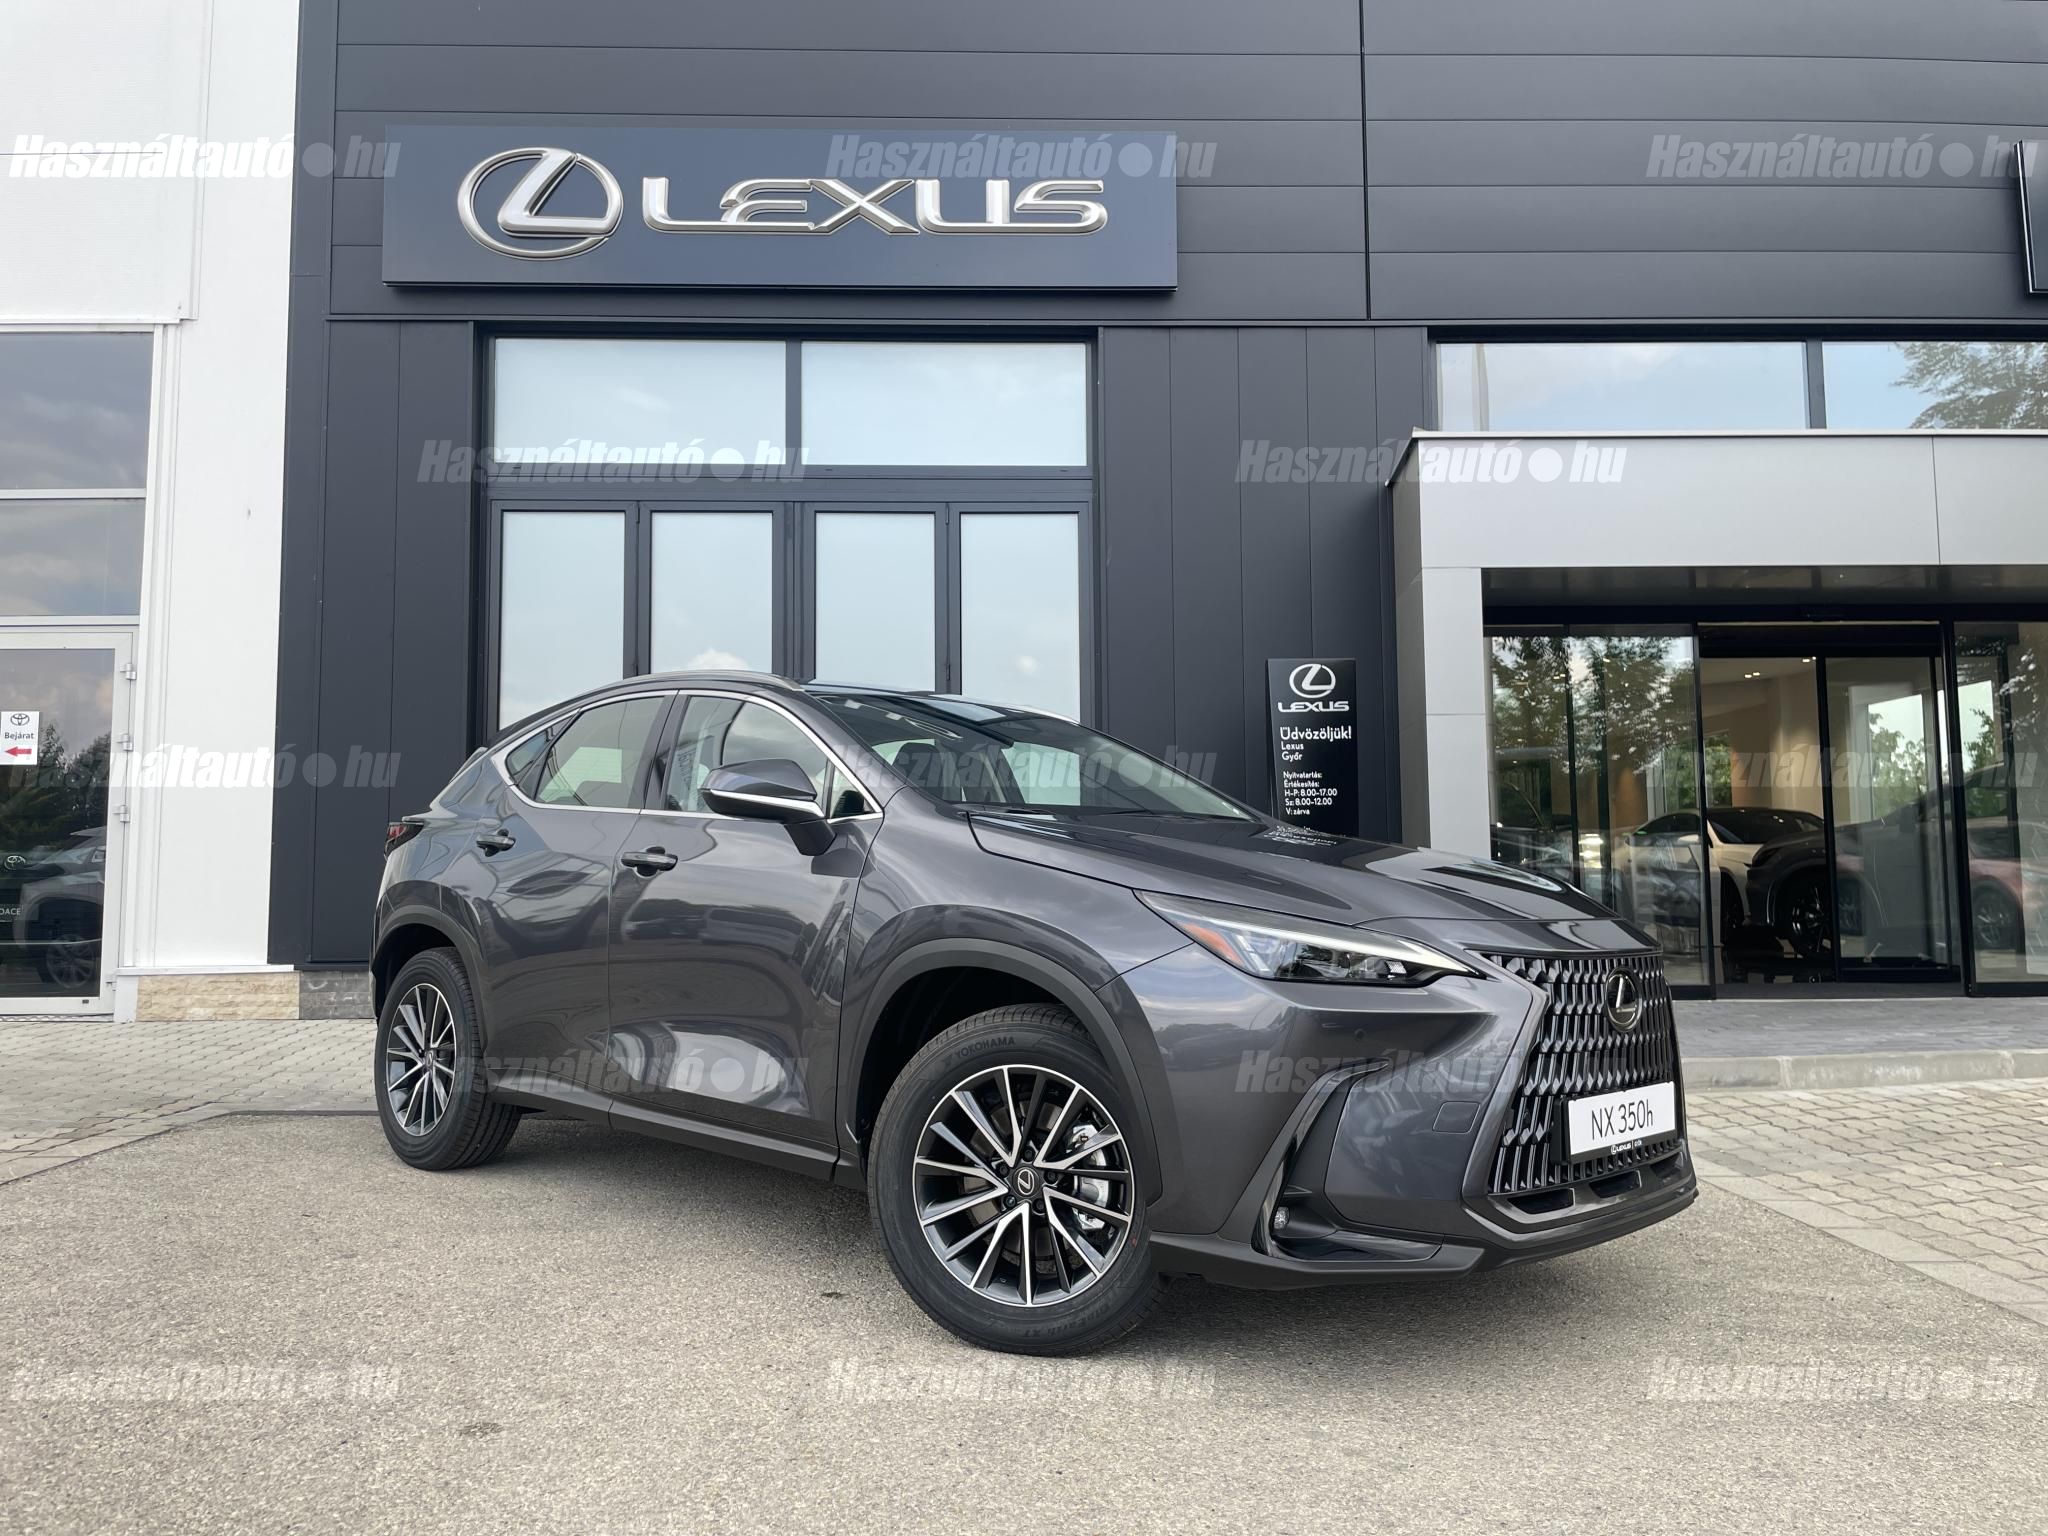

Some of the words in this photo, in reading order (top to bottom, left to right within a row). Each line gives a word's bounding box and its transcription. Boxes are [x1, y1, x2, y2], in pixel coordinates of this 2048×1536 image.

[642, 177, 1108, 236] LEXUS
[1278, 701, 1350, 712] LEXUS
[4, 732, 34, 740] Bejárat
[1280, 725, 1352, 742] Üdvözöljük!
[1281, 741, 1304, 750] Lexus
[1281, 751, 1303, 762] Győr
[955, 1036, 1016, 1058] YOKOHAMA
[1591, 1106, 1615, 1141] NX
[1618, 1098, 1653, 1134] 350h
